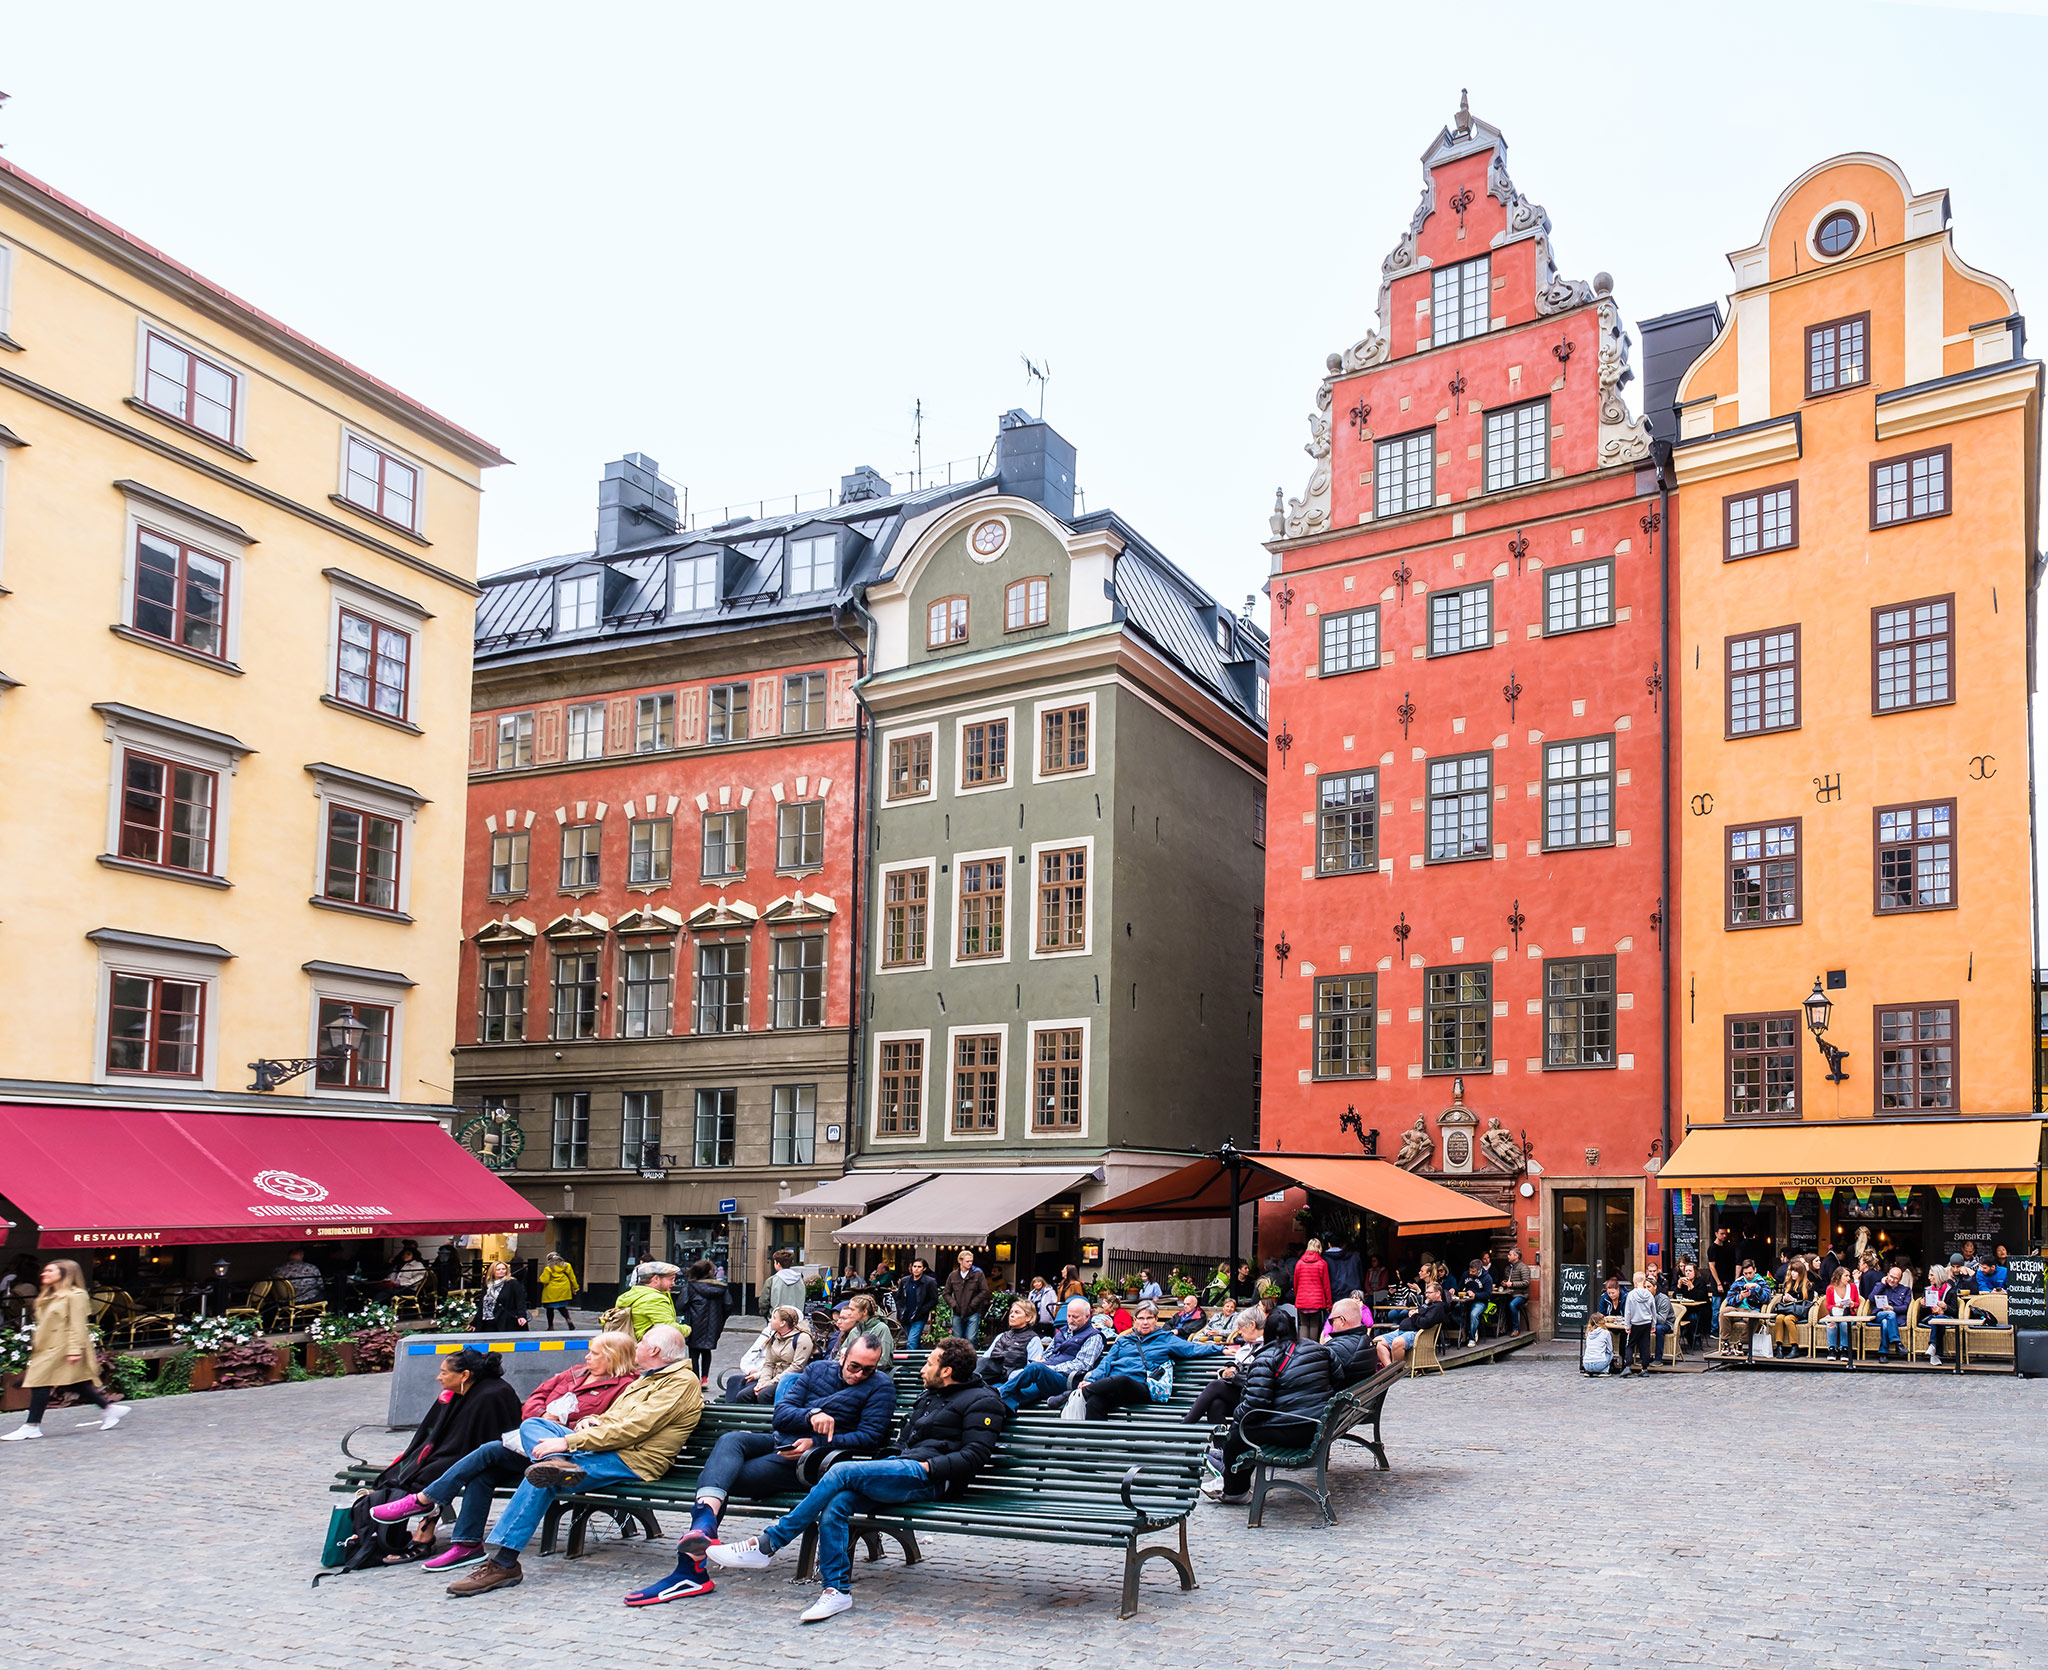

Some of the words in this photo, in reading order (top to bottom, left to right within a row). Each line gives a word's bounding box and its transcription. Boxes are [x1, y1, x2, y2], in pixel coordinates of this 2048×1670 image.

[1955, 1197, 1994, 1206] DRYCK
[514, 1222, 530, 1230] BAR
[73, 1232, 161, 1242] RESTAURANT
[1562, 1267, 1586, 1280] TAKE
[1563, 1281, 1587, 1296] AWAY
